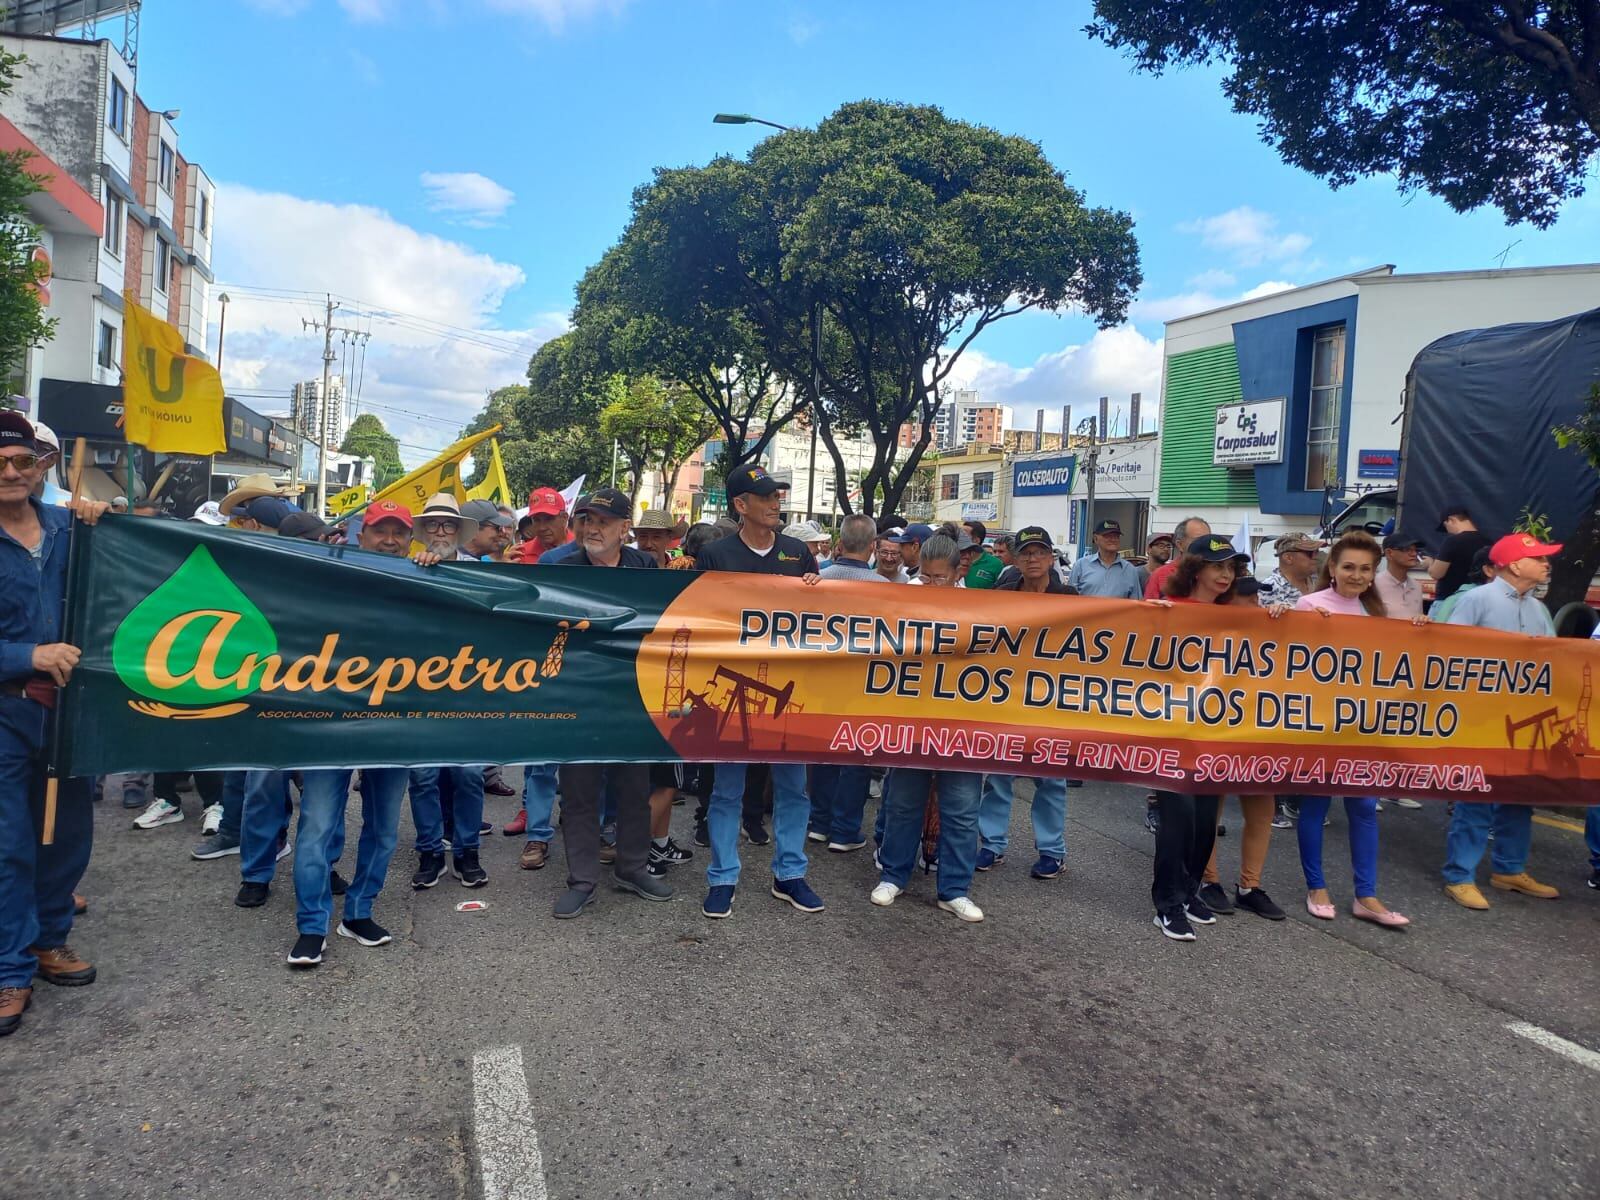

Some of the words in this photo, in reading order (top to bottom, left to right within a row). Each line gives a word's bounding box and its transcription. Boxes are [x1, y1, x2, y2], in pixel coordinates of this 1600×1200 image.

[1216, 430, 1278, 453] Corposalud
[1017, 467, 1069, 487] COLSERAUTO
[1111, 461, 1142, 474] Peritaje
[739, 609, 958, 657] PRESENTE
[966, 623, 1029, 657] EN
[1032, 625, 1116, 663] LAS
[1121, 632, 1277, 677] LUCHAS
[1285, 643, 1363, 687] POR
[1371, 650, 1415, 689] LA
[1422, 655, 1551, 697] DEFENSA
[864, 659, 923, 698] DE
[932, 661, 1014, 704] LOS
[1023, 669, 1247, 728] DERECHOS
[1254, 690, 1325, 732] DEL
[1333, 696, 1458, 738] PUEBLO
[257, 711, 334, 719] ASOCIACION
[342, 711, 403, 719] NACIONAL
[407, 711, 423, 719] DE
[426, 711, 505, 719] PENSIONADOS
[509, 712, 577, 720] PETROLEROS
[830, 721, 915, 756] AQUI
[920, 726, 1026, 762] NADIE
[1031, 737, 1071, 765] SE
[1075, 741, 1186, 780] RINDE.
[1194, 753, 1290, 783] SOMOS
[1291, 757, 1326, 783] LA
[1331, 758, 1493, 793] RESISTENCIA.
